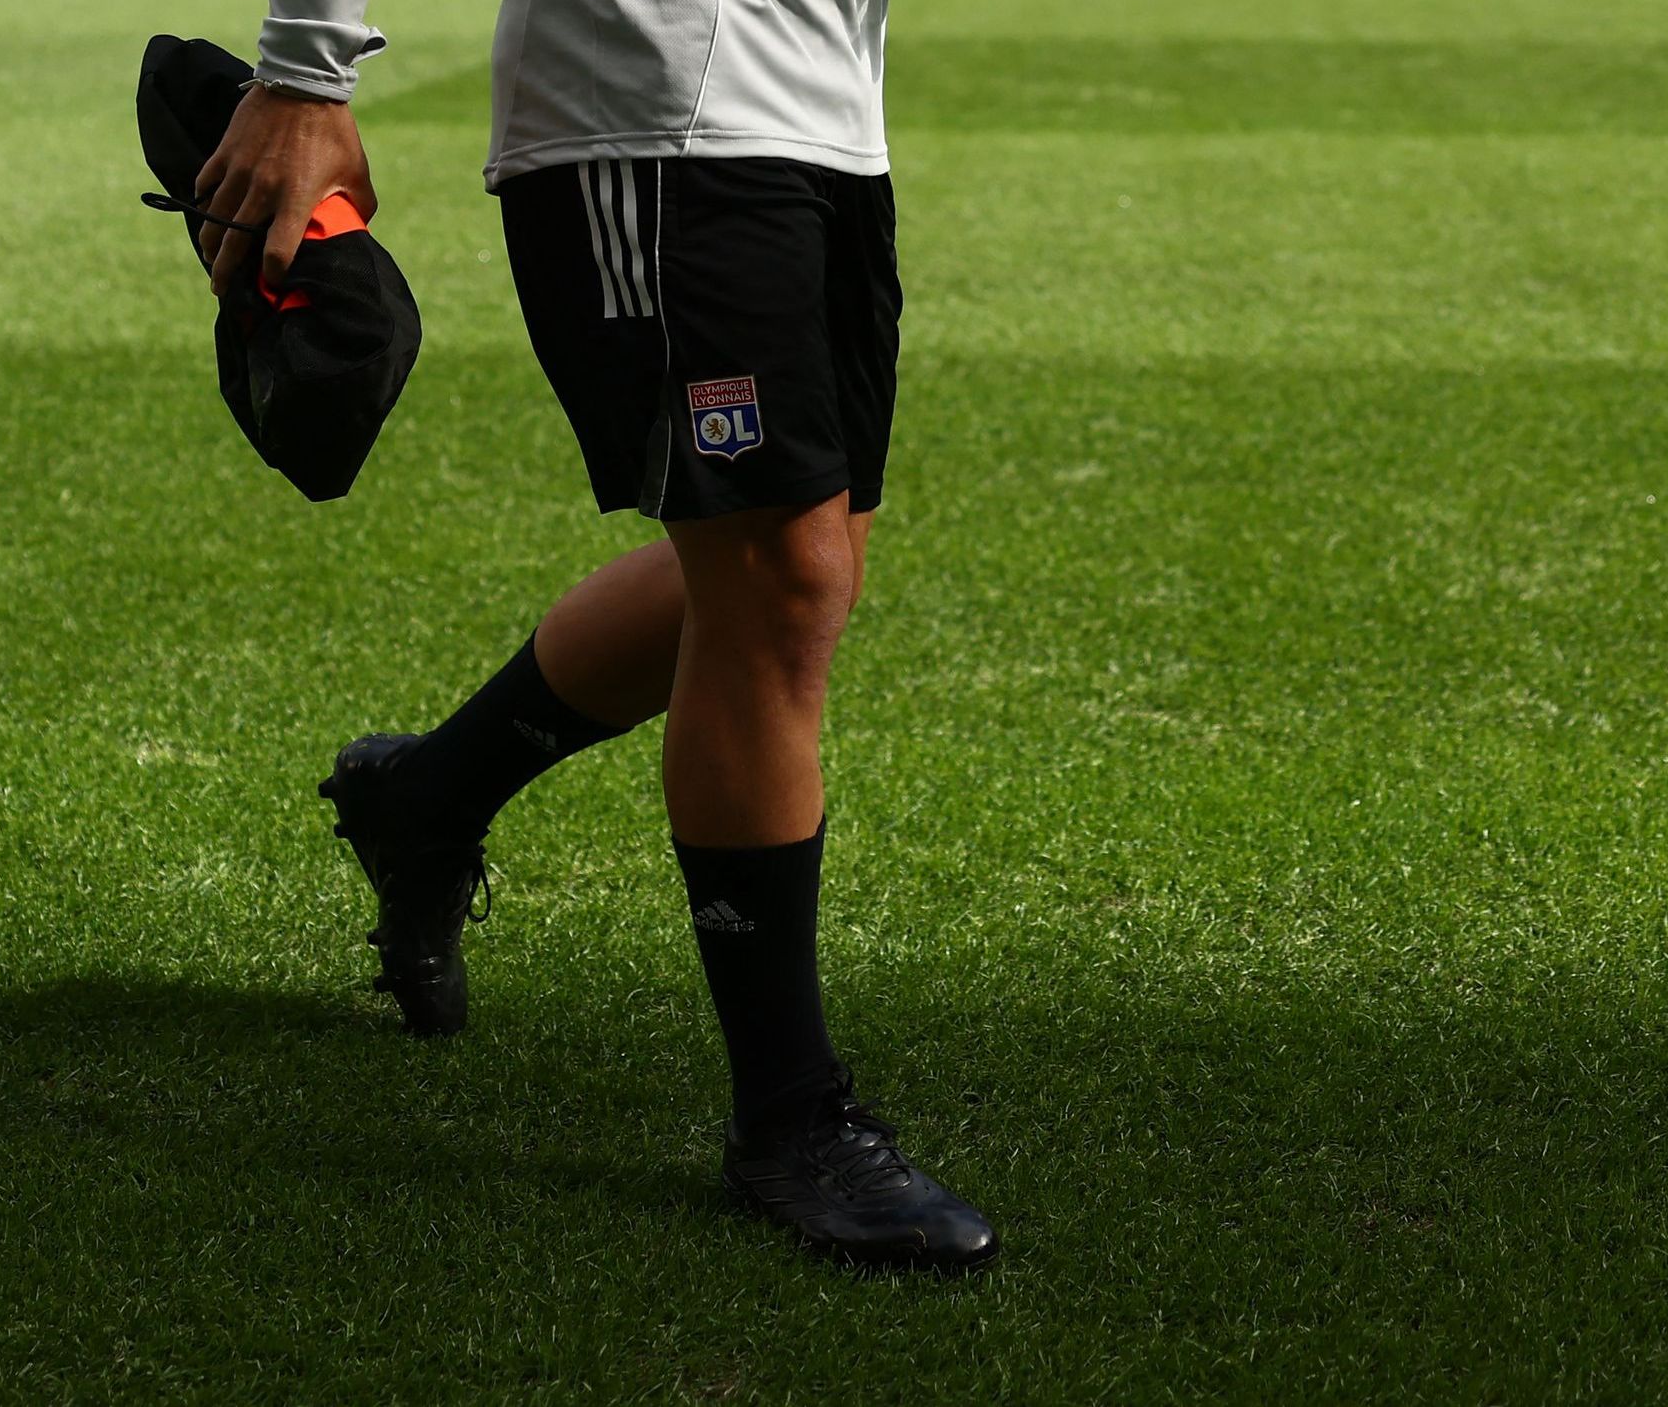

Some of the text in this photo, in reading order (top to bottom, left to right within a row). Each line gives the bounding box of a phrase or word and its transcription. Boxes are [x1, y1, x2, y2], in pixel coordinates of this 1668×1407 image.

[693, 381, 750, 395] OLYMPIQUE
[694, 392, 752, 406] LYONNAIS
[700, 410, 755, 445] OL
